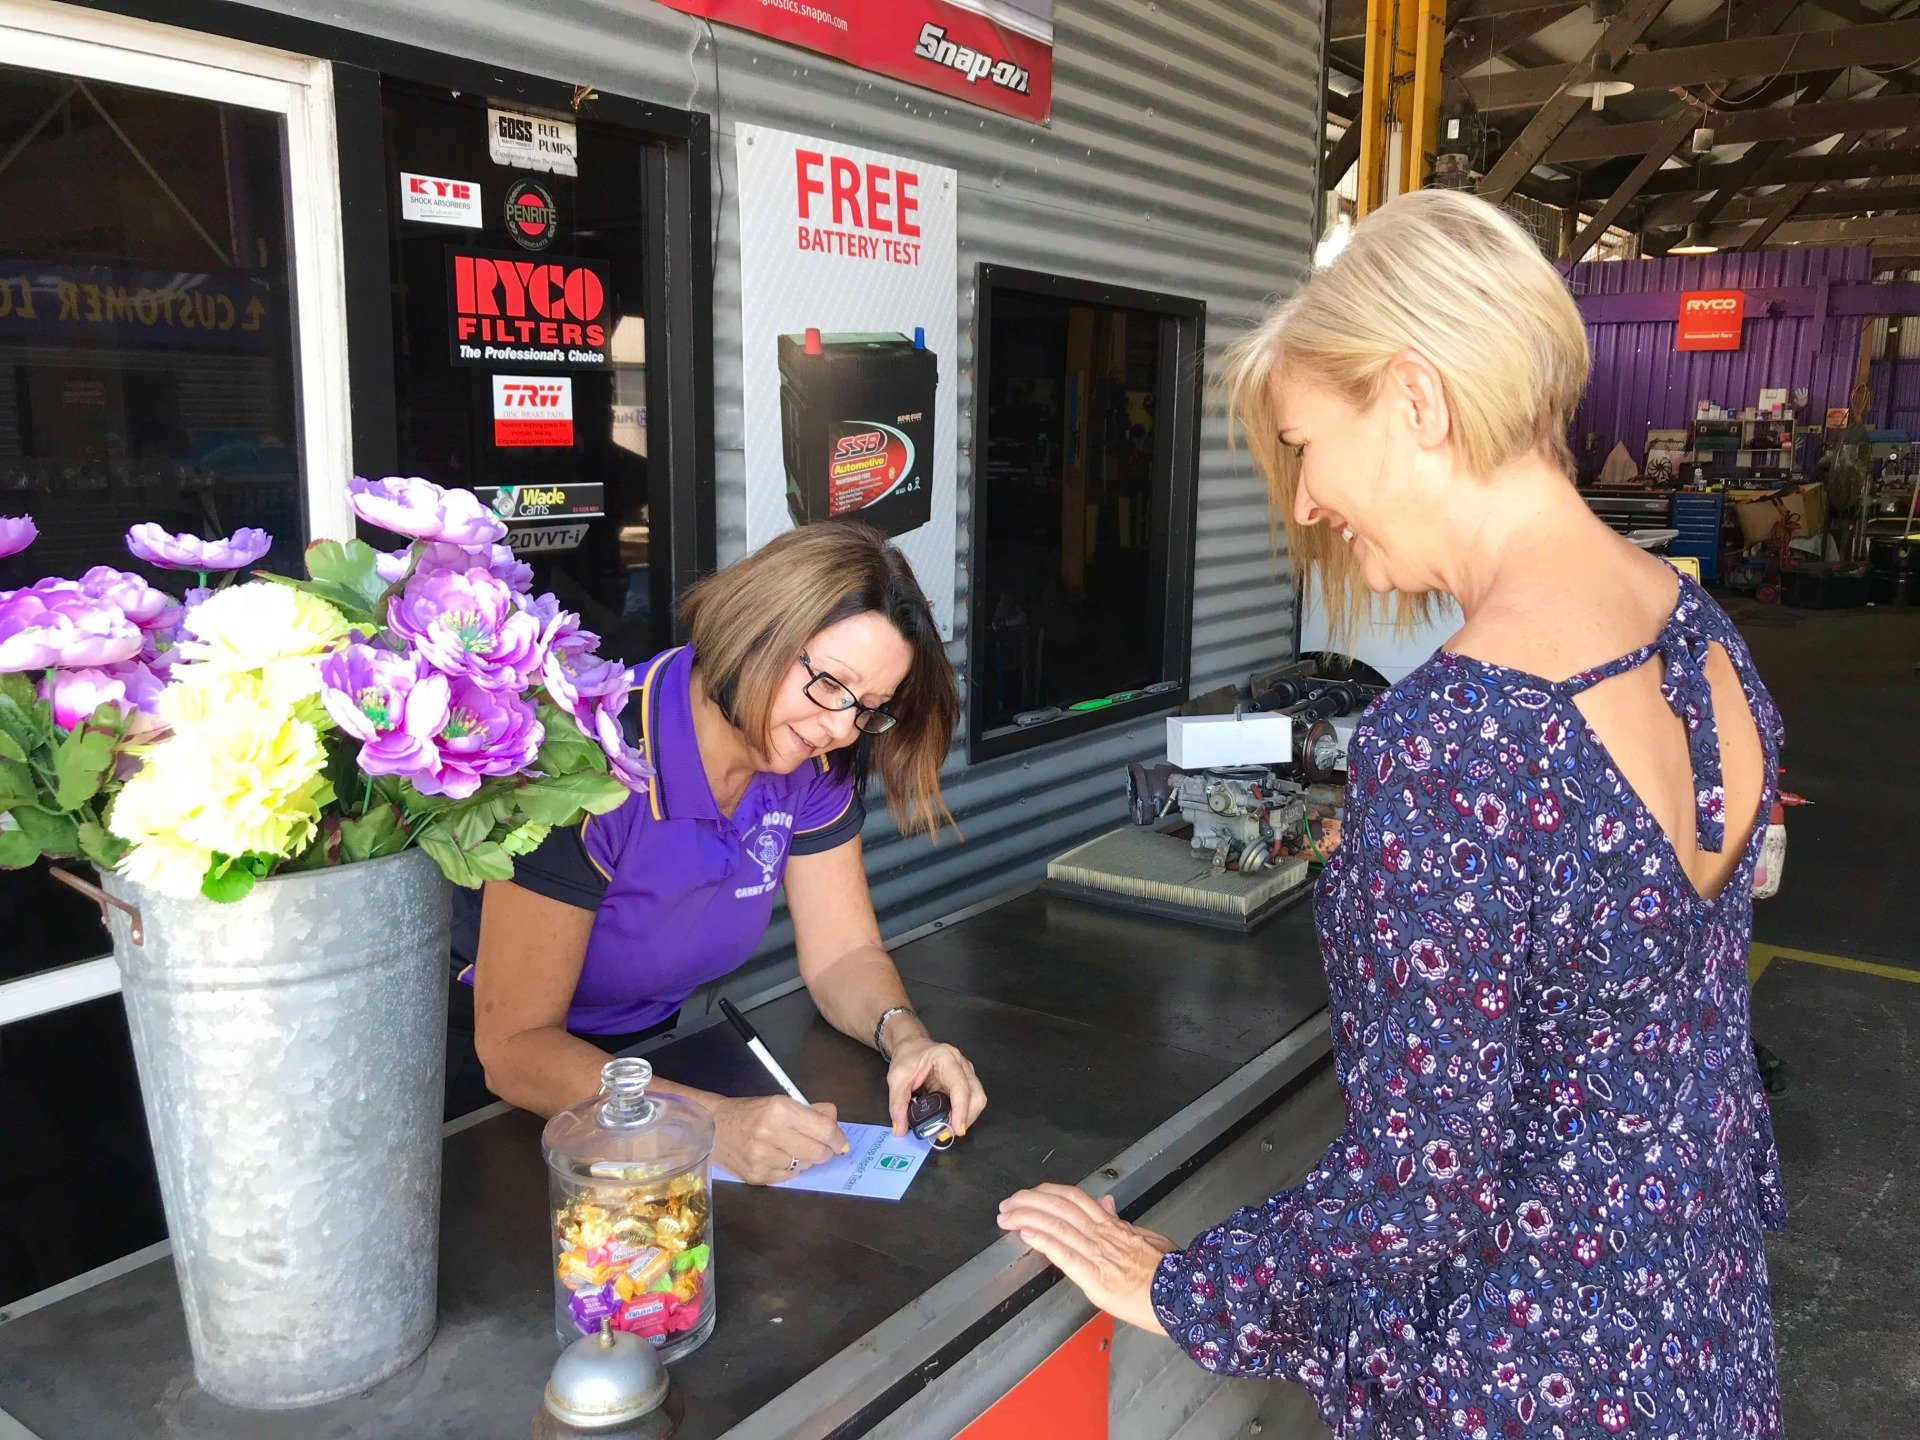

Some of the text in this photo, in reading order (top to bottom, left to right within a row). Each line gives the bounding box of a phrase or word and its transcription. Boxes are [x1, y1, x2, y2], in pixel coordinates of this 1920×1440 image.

[914, 22, 1030, 94] Snap-on
[499, 115, 533, 143] GOSS
[538, 123, 561, 139] FUEL
[539, 139, 572, 156] PUMPS
[410, 177, 471, 200] KYB
[795, 148, 921, 238] FREE
[410, 196, 471, 211] SHOCK ABSORBERS
[506, 203, 556, 226] PENRITE
[798, 225, 921, 267] BATTERY TEST
[455, 256, 604, 322] RYCO
[1686, 298, 1737, 311] RYCO
[458, 317, 605, 347] FILTERS
[460, 345, 605, 363] The Professional's Choice
[503, 384, 563, 407] TRW
[835, 432, 881, 459] SSB
[834, 457, 885, 475] Automotive
[523, 487, 566, 506] Wade
[519, 503, 550, 516] Cams
[843, 1130, 891, 1191] Workshop Repair Ticket
